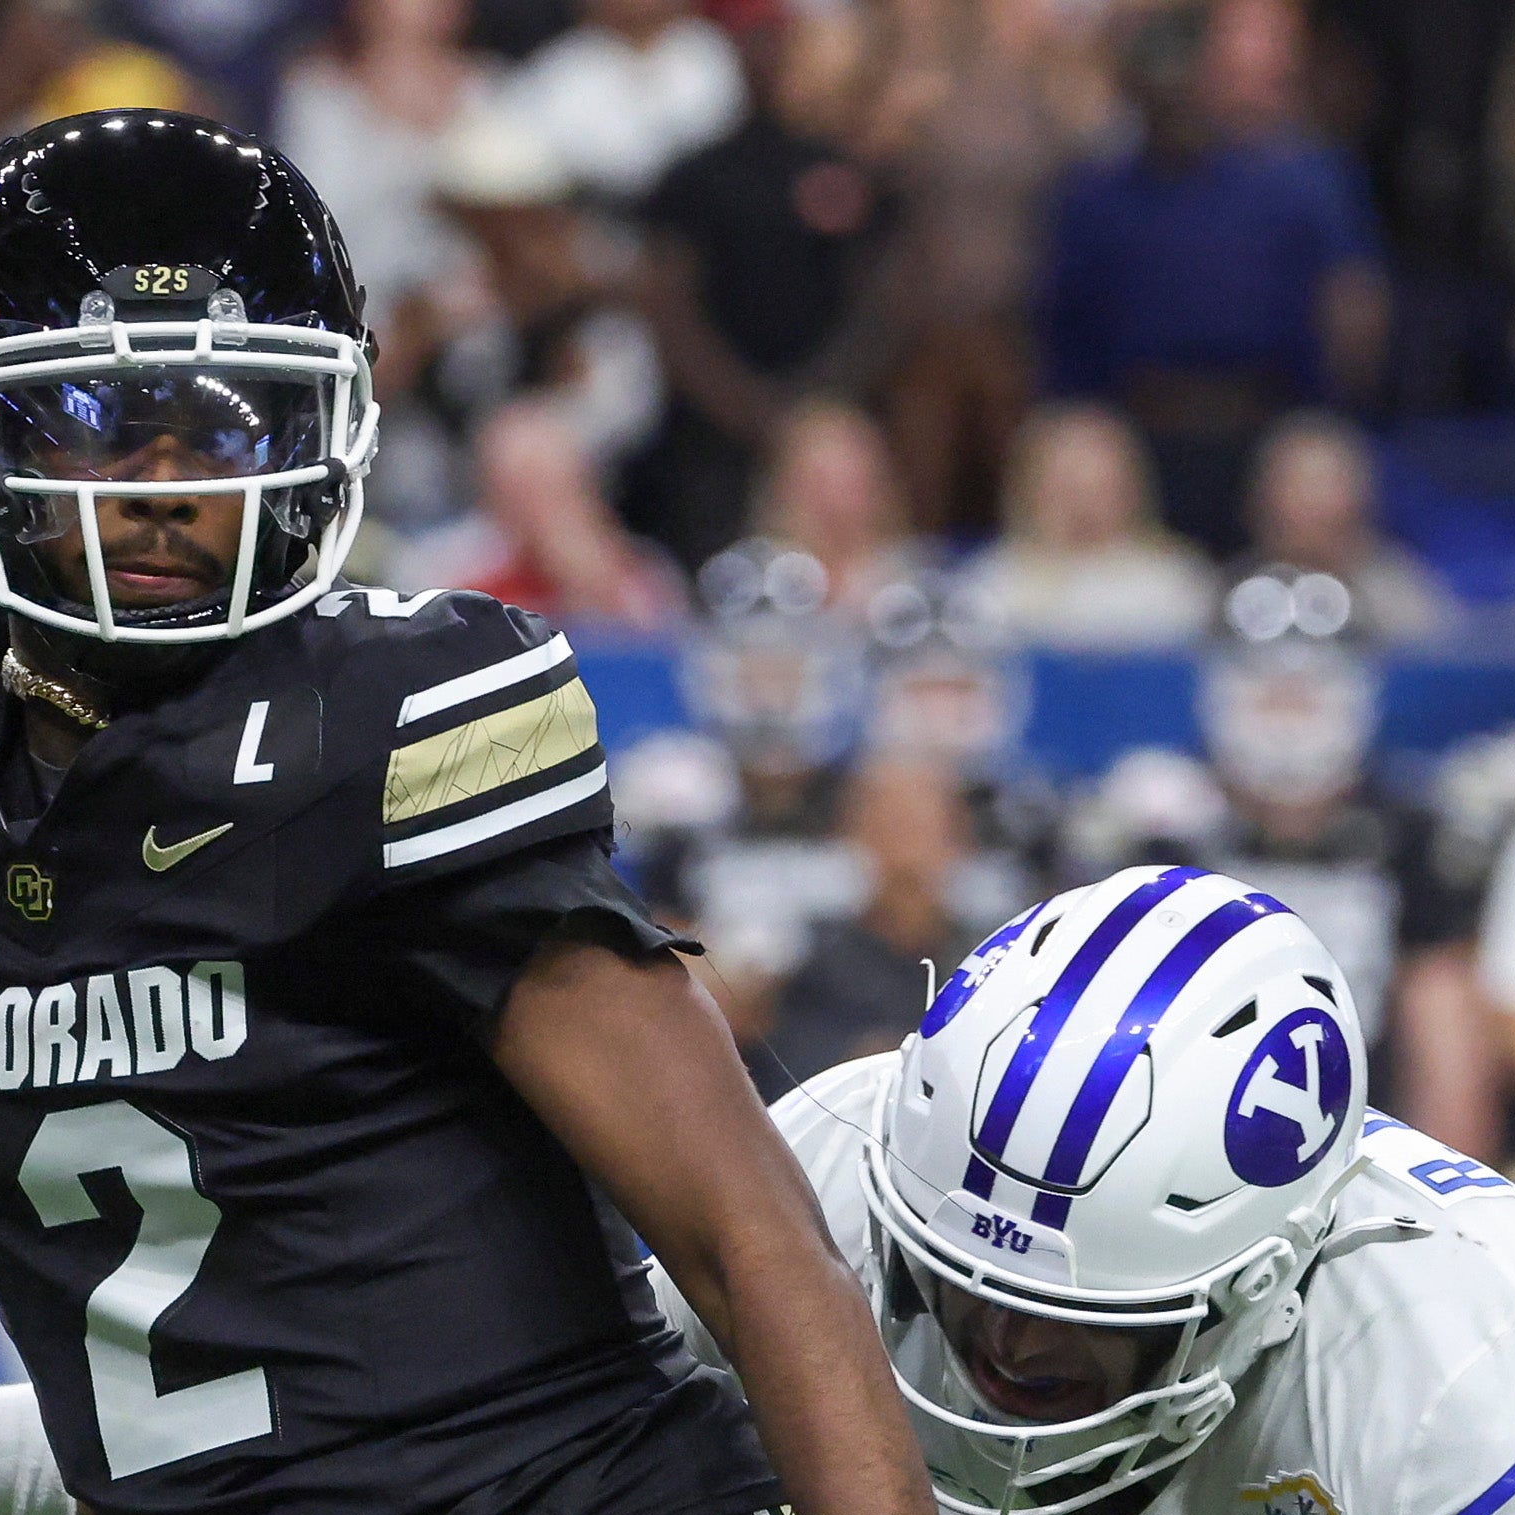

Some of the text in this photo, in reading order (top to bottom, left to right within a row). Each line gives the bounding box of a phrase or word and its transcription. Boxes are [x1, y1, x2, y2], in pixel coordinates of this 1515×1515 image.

[134, 266, 189, 296] S2S
[233, 701, 274, 785] L
[1237, 1023, 1336, 1164] Y
[971, 1213, 1034, 1255] BYU
[18, 1099, 273, 1481] 2
